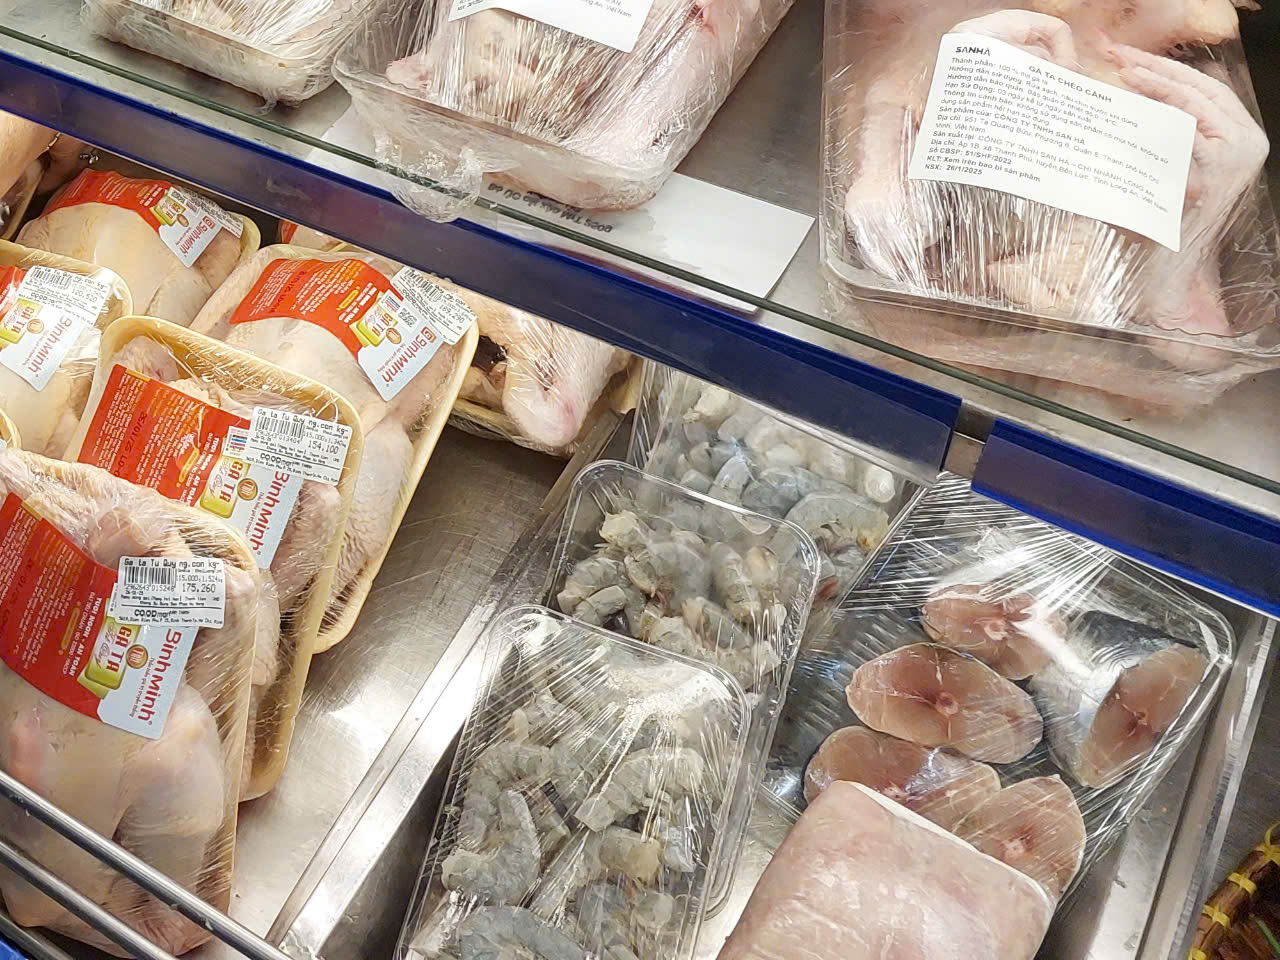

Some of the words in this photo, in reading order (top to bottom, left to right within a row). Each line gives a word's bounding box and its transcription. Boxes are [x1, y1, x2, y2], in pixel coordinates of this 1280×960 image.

[955, 46, 991, 57] SANHÀ
[1045, 71, 1056, 81] TA
[308, 439, 339, 455] 154.100
[218, 483, 236, 503] TA
[123, 558, 134, 566] Ga
[150, 559, 160, 567] Tu
[163, 559, 177, 569] Quy
[178, 560, 205, 569] ng.con
[182, 583, 216, 593] 175.260
[106, 651, 125, 673] TA
